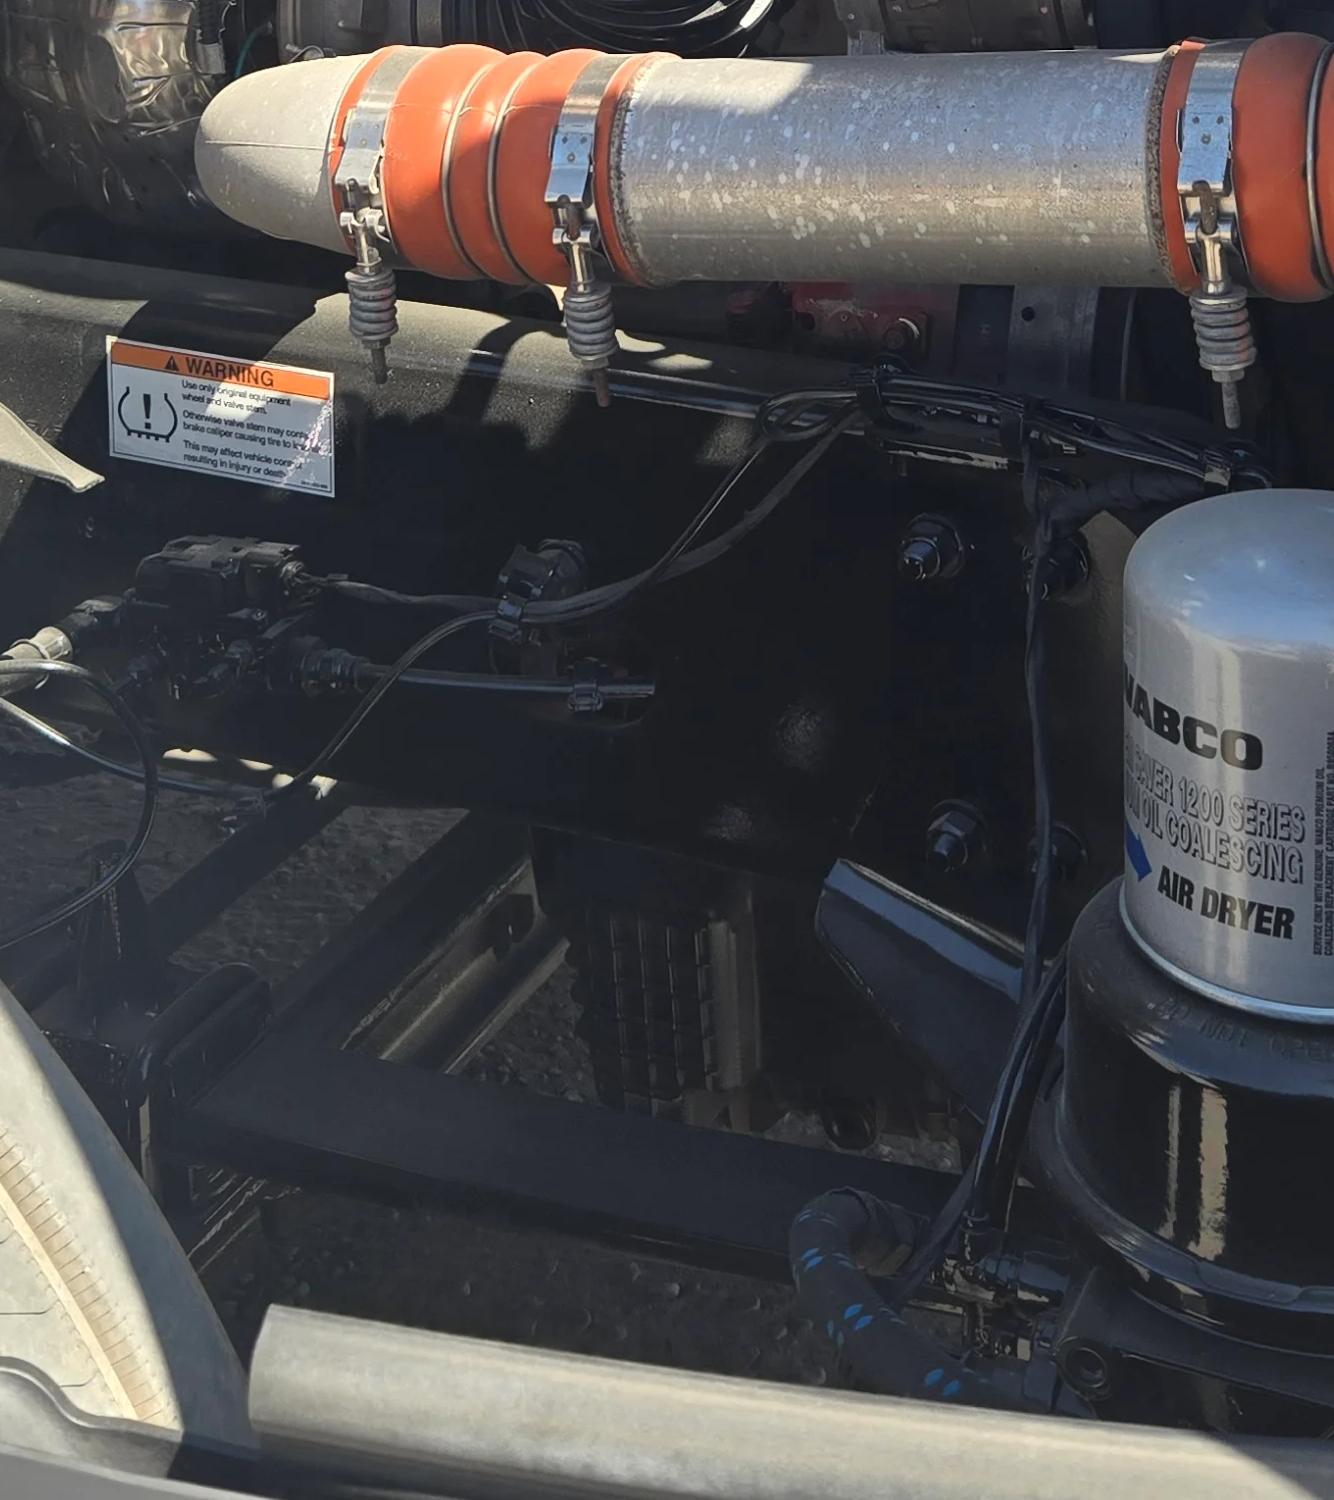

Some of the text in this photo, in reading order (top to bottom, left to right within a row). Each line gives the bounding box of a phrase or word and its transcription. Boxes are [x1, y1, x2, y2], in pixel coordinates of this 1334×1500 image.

[186, 357, 274, 387] WARNING
[182, 379, 291, 407] Use only original equipment
[182, 392, 205, 404] wheel
[206, 395, 222, 406] and
[223, 398, 244, 410] valve
[182, 409, 222, 424] Otherwise
[223, 417, 245, 429] valve
[246, 420, 266, 433] stem
[267, 426, 284, 438] may
[182, 421, 205, 434] brake
[234, 430, 266, 445] causing
[267, 435, 281, 447] tire
[282, 439, 291, 449] to
[183, 439, 200, 451] This
[201, 444, 218, 456] may
[219, 446, 243, 460] affect
[244, 451, 272, 464] vehicle
[183, 453, 218, 468] resulting
[219, 458, 227, 467] in
[228, 460, 251, 474] injury
[252, 465, 262, 474] or
[1178, 776, 1224, 827] 1200
[1228, 795, 1306, 844] SERIES
[1315, 781, 1325, 817] PREMIUM
[1326, 786, 1334, 807] PART
[1314, 818, 1324, 845] WABCO
[1325, 808, 1334, 852] CARTRIDGE
[1166, 810, 1304, 884] COALESCING
[1314, 849, 1324, 881] GENUINE
[1314, 883, 1323, 903] WITH
[1325, 855, 1334, 909] REPLACEMENT
[1158, 865, 1295, 940] AIR DRYER
[1313, 904, 1323, 923] ONLY
[1313, 925, 1323, 956] SERVICE
[1324, 910, 1334, 956] COALESCING
